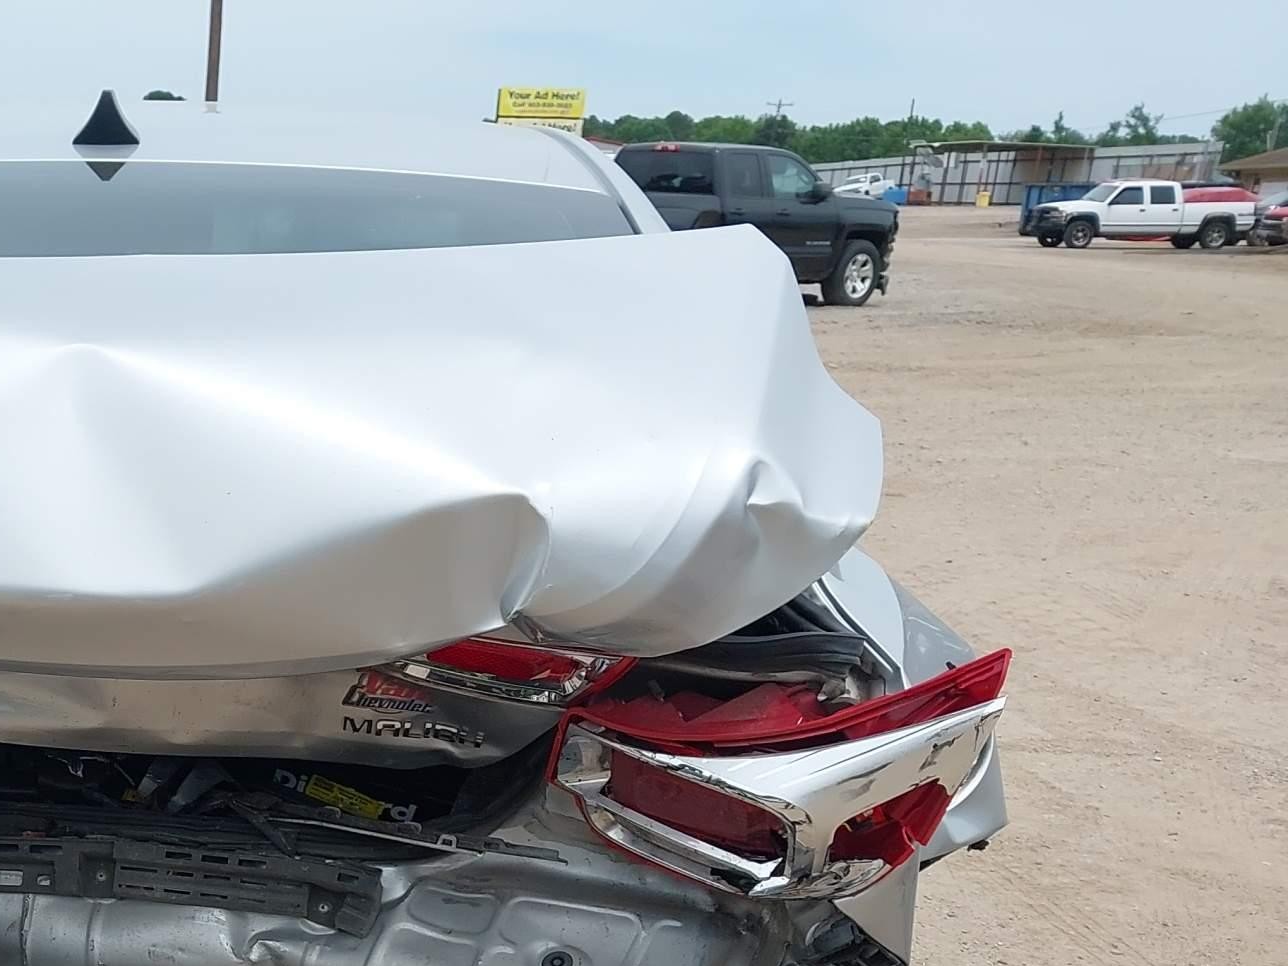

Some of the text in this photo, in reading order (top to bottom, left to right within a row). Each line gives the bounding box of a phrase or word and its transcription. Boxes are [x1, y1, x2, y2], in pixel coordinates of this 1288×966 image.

[508, 91, 580, 101] Your Ad Here!
[342, 684, 436, 714] Chevrolet
